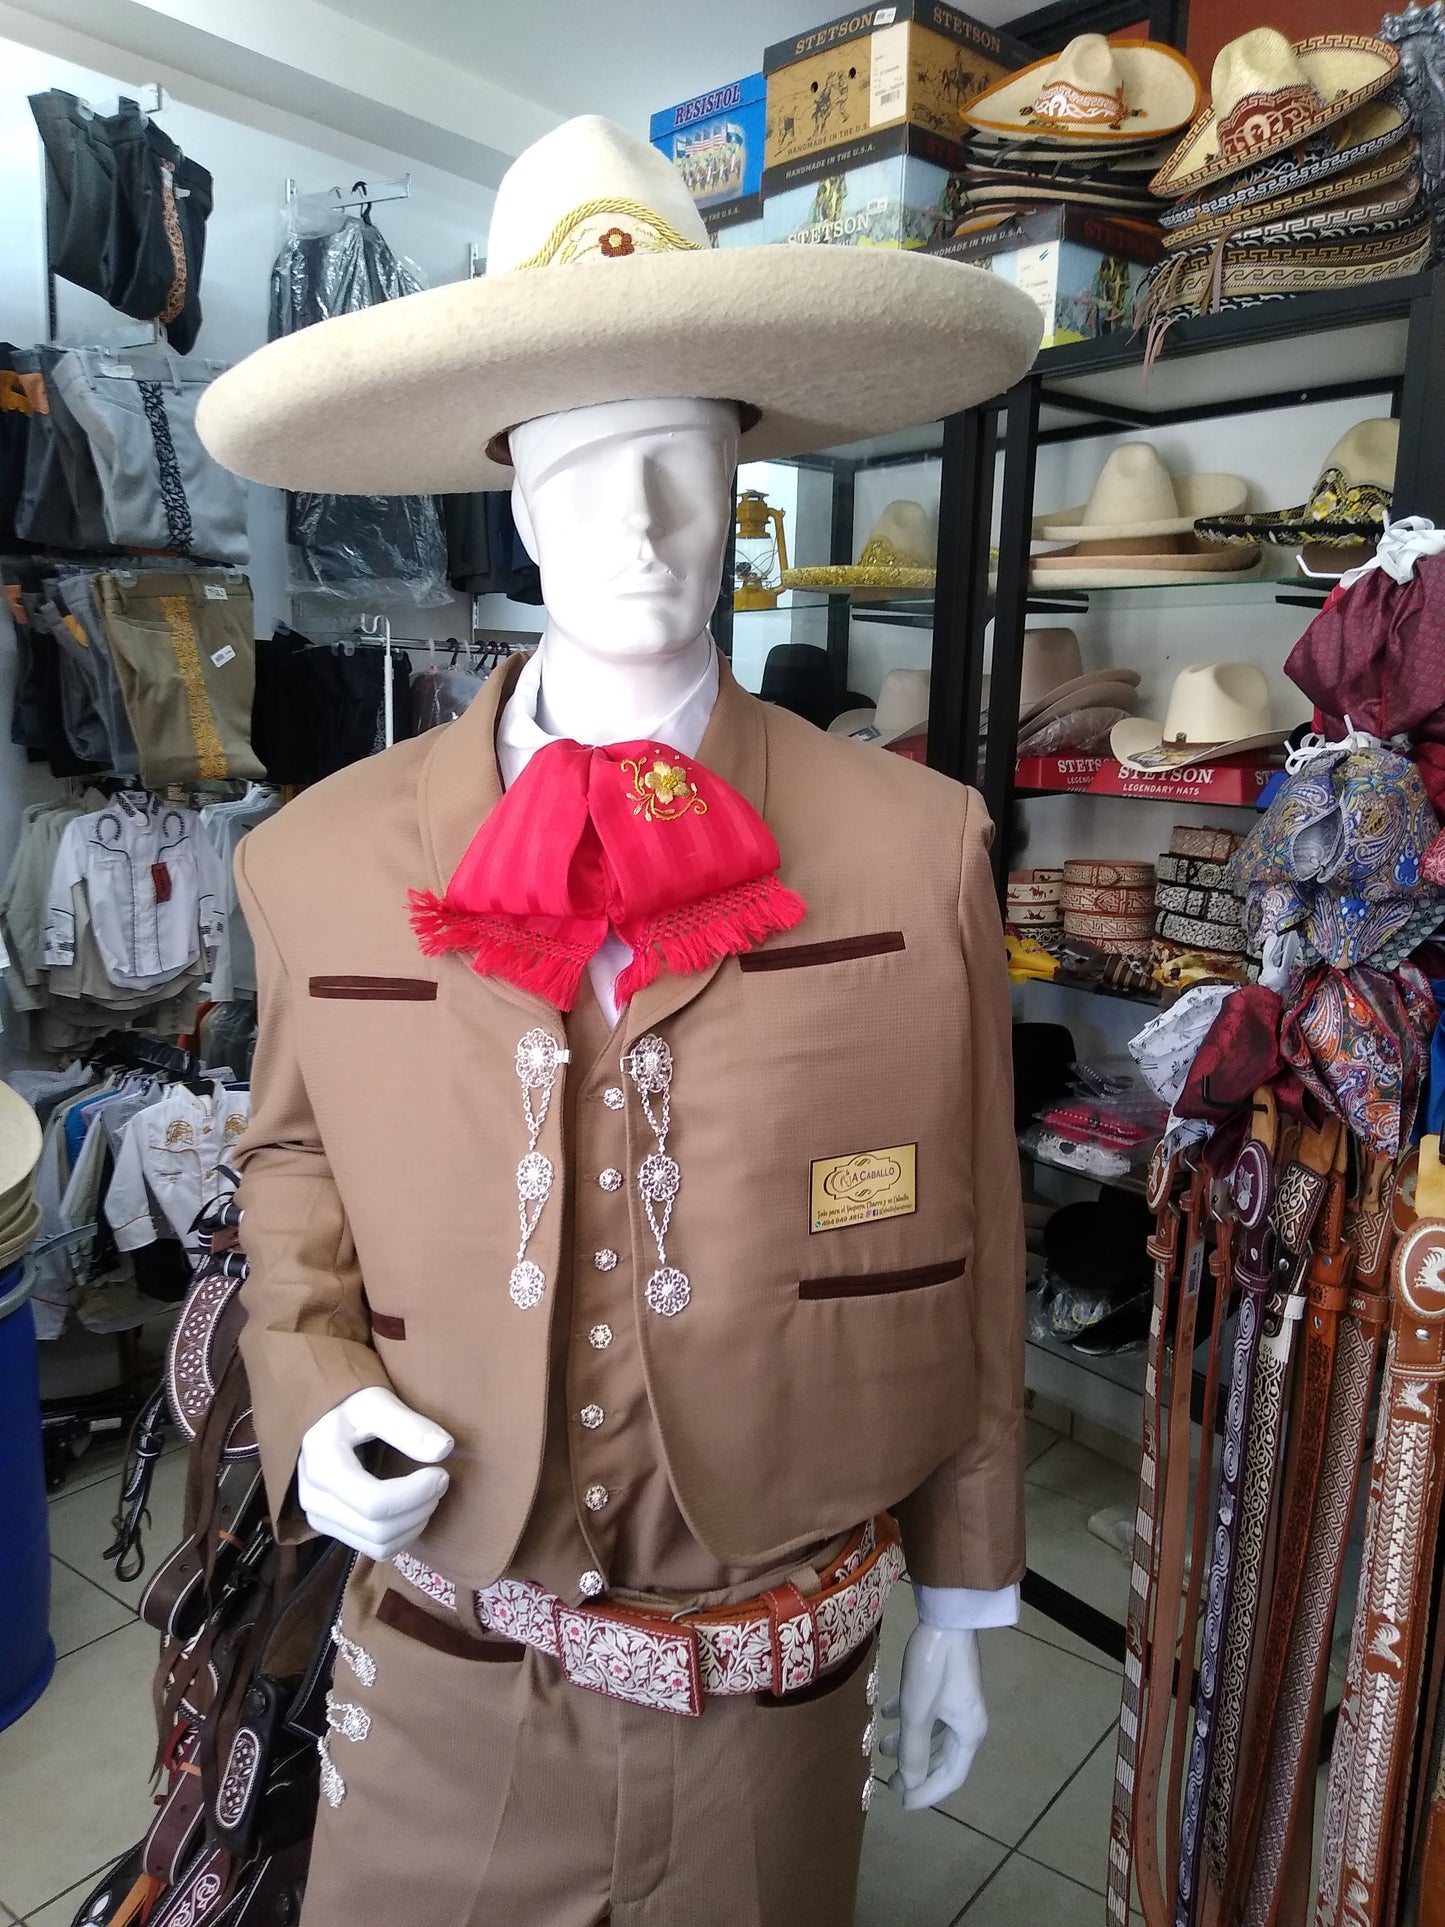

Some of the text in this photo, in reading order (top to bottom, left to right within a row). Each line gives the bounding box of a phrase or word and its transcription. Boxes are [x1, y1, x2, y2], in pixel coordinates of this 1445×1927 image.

[794, 11, 874, 55] STETSON
[933, 6, 1001, 53] STETSON
[674, 83, 740, 125] RESISTOL
[787, 137, 827, 156] HANDMADE
[829, 133, 838, 142] IN
[840, 127, 853, 138] THE
[785, 143, 876, 179] HANDMADE IN THE U.S.A.
[968, 239, 979, 248] IN
[980, 233, 998, 245] THE
[999, 226, 1025, 240] U.S.A.
[1123, 783, 1200, 796] LEGENDARY HATS
